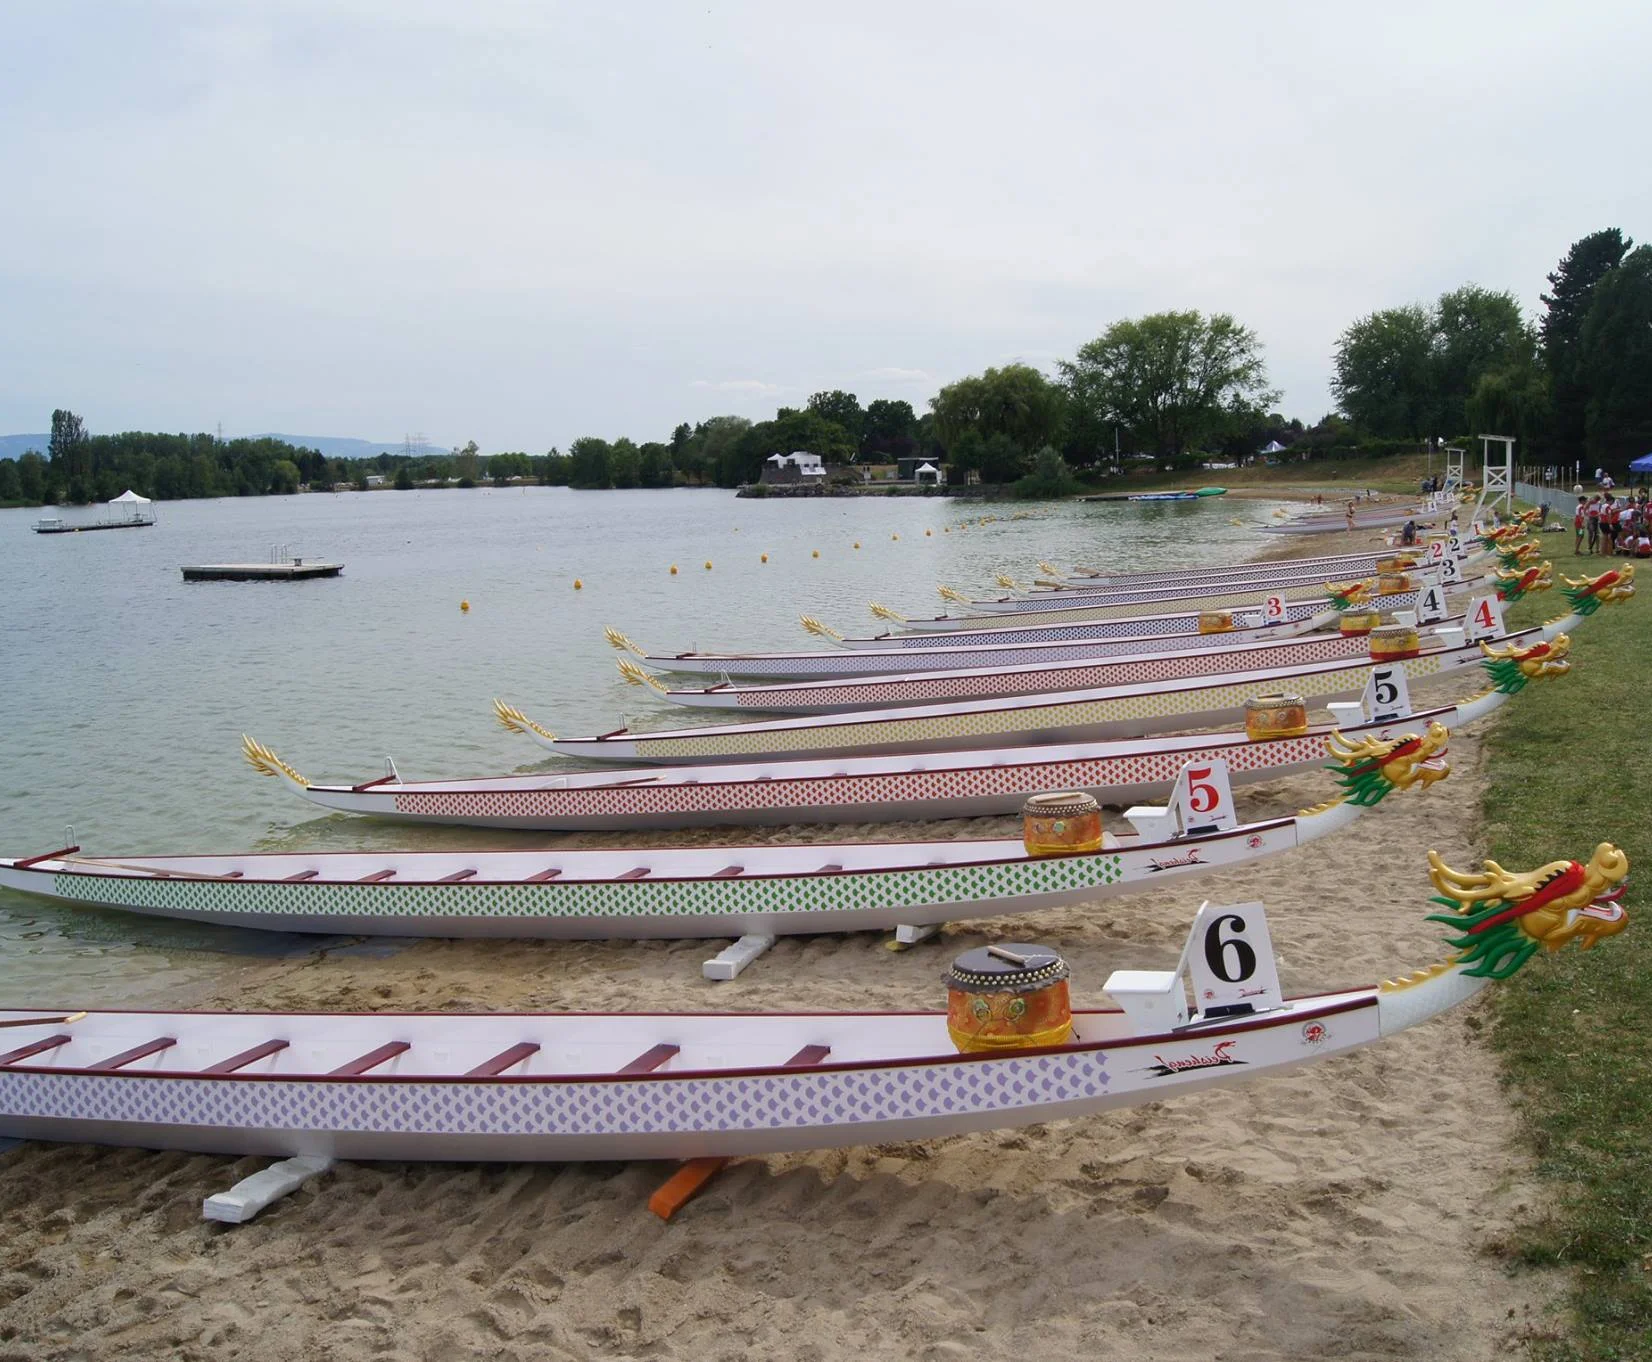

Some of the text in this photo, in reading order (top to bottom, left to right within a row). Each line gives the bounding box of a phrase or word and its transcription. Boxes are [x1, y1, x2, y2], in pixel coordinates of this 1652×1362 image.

[1432, 543, 1442, 557] 2
[1450, 538, 1460, 552] 2
[1442, 559, 1455, 576] 3
[1267, 597, 1282, 616] 3
[1423, 589, 1440, 611] 4
[1475, 600, 1496, 628] 4
[1374, 670, 1398, 704] 5
[1188, 767, 1219, 812] 5
[1204, 914, 1256, 983] 6
